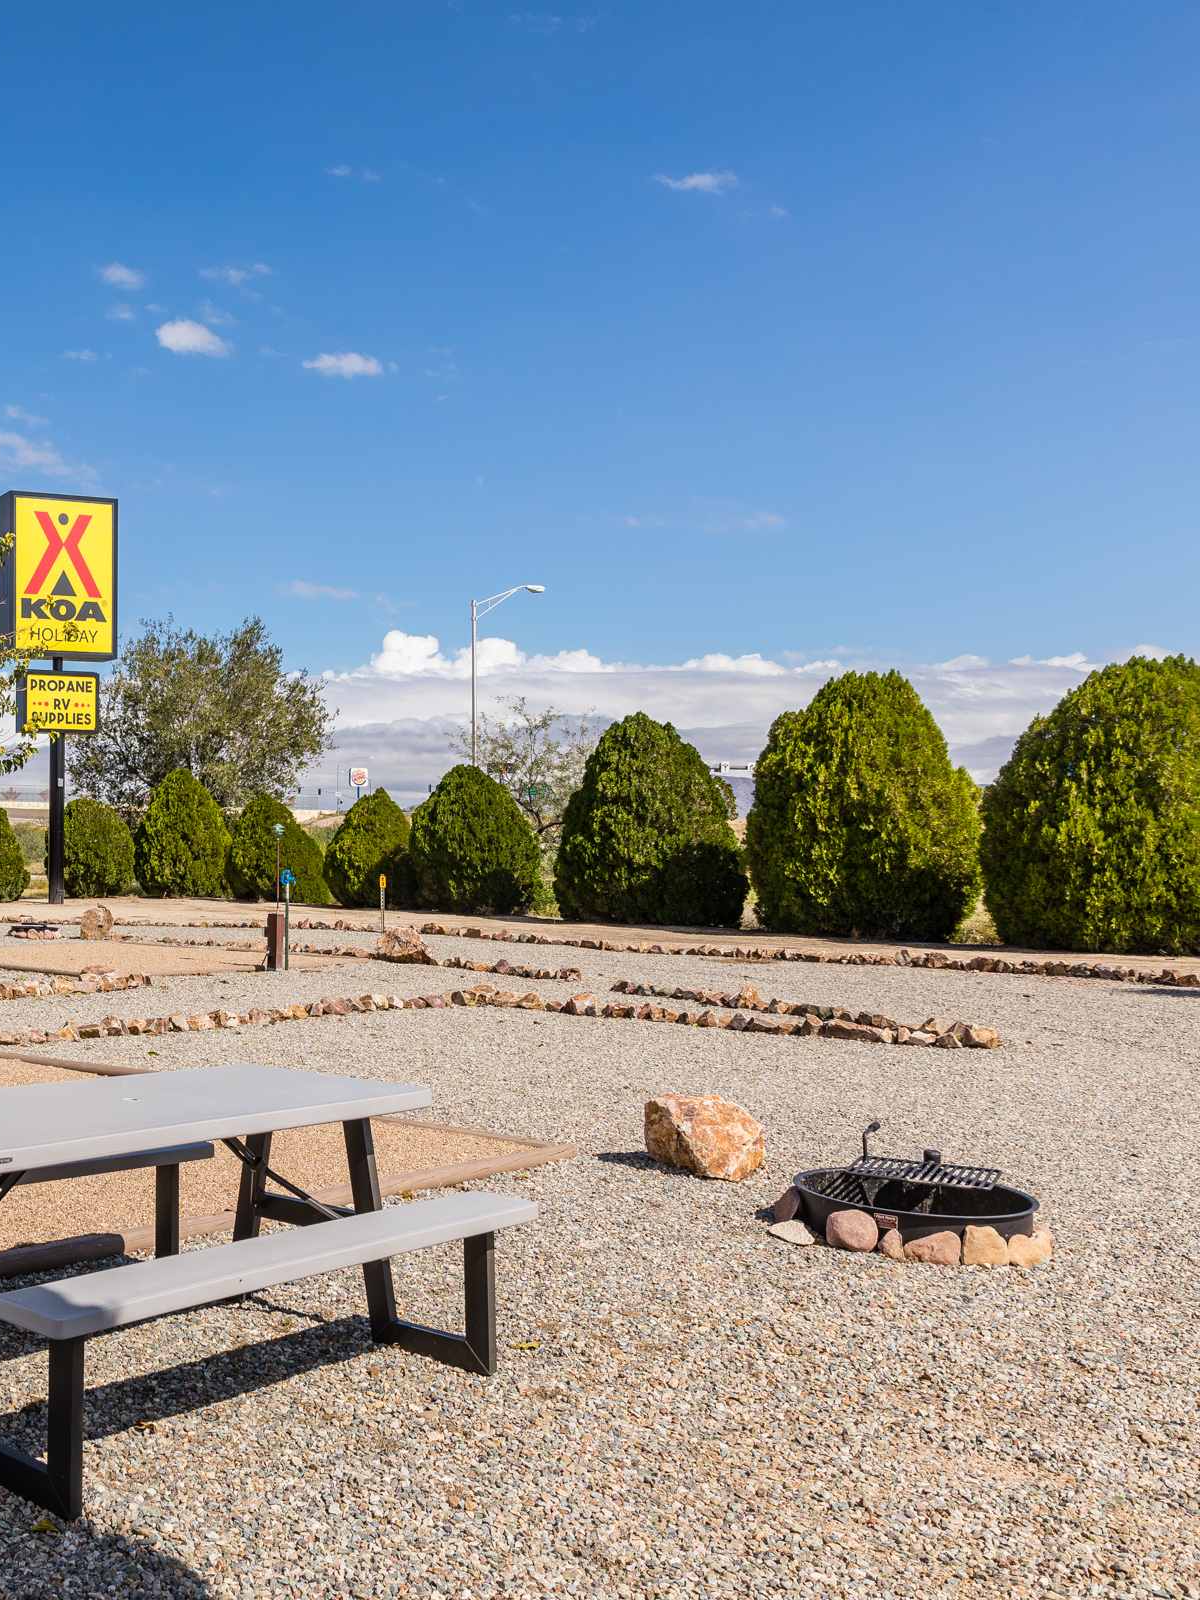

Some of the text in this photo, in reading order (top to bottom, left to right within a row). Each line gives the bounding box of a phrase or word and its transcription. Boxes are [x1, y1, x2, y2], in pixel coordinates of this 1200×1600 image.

[21, 598, 107, 622] KOA
[30, 679, 93, 693] PROPANE
[53, 698, 71, 710] RV
